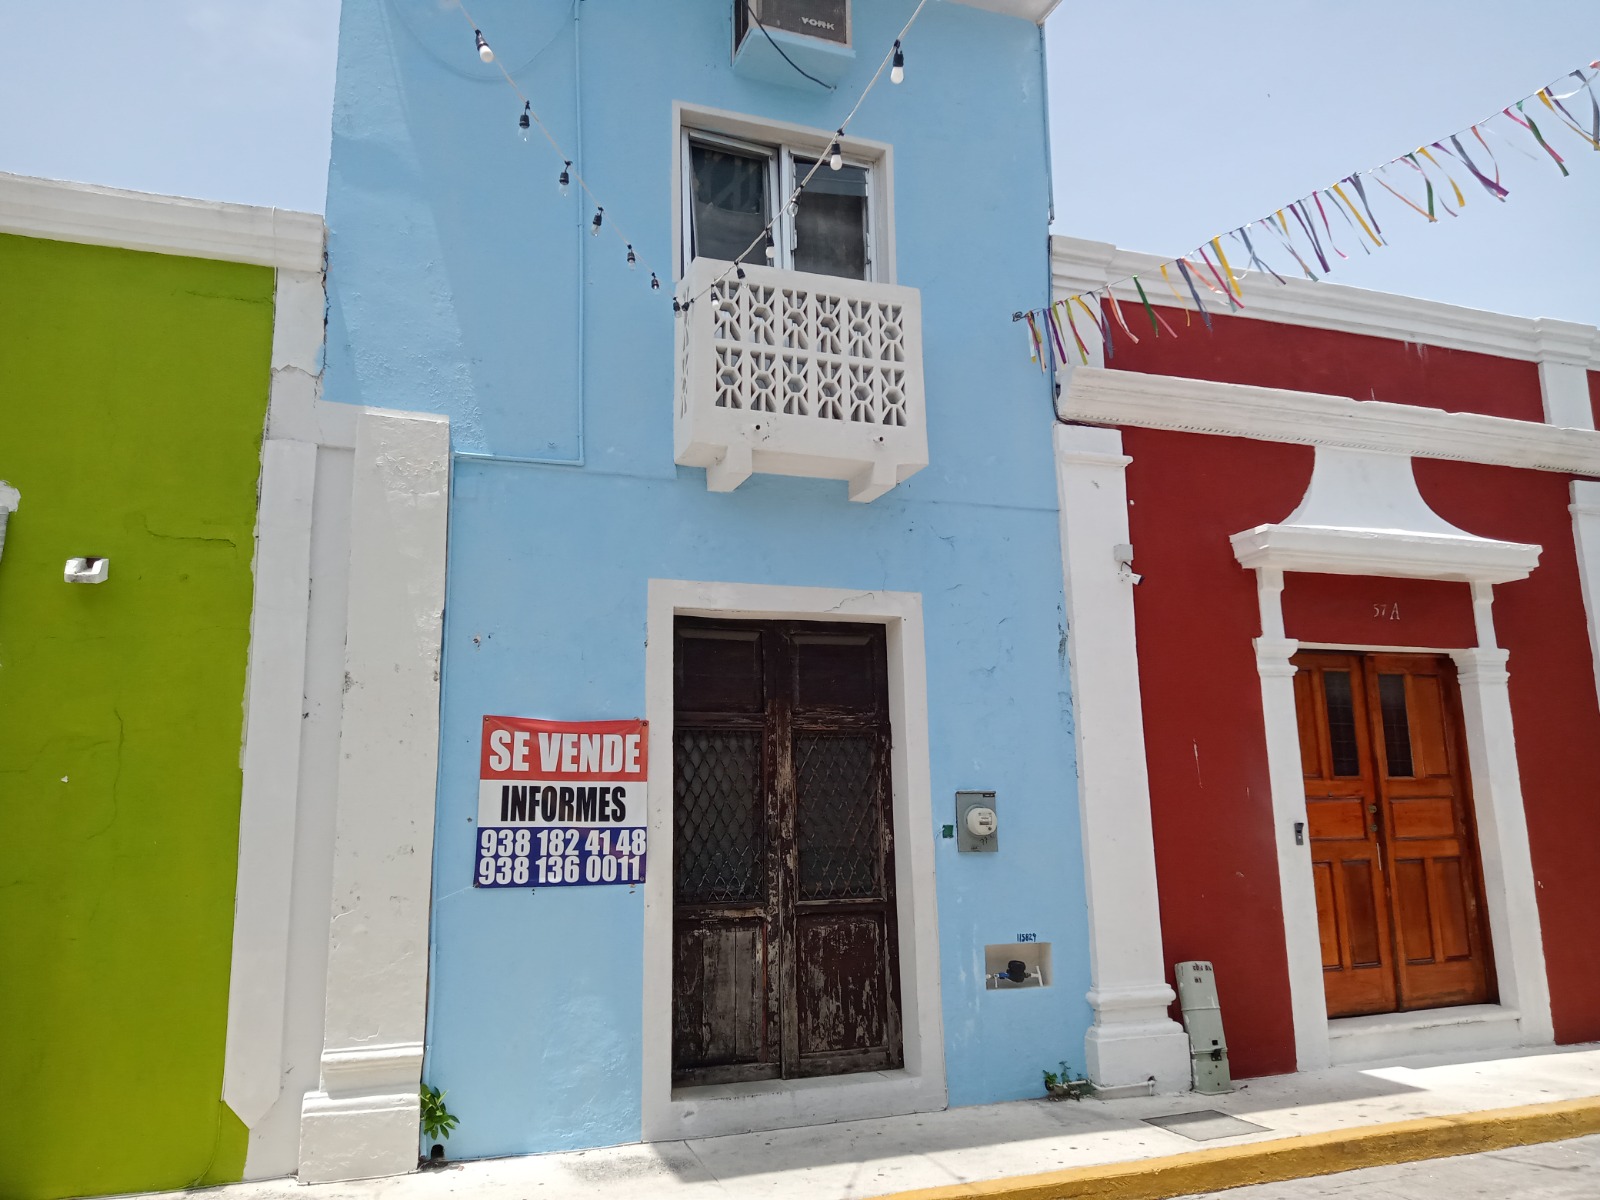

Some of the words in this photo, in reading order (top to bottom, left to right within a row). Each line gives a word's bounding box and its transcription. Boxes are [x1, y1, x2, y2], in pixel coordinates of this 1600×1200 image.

[801, 16, 835, 31] YORK
[1373, 603, 1387, 618] 57
[1389, 602, 1401, 620] A
[489, 730, 530, 772] SE
[538, 732, 641, 773] VENDE
[501, 785, 626, 823] INFORMES
[480, 829, 531, 857] 938
[537, 829, 579, 856] 182
[584, 829, 611, 855] 41
[615, 828, 646, 855] 48
[478, 856, 529, 885] 938
[536, 855, 579, 884] 136
[585, 855, 640, 883] 0011
